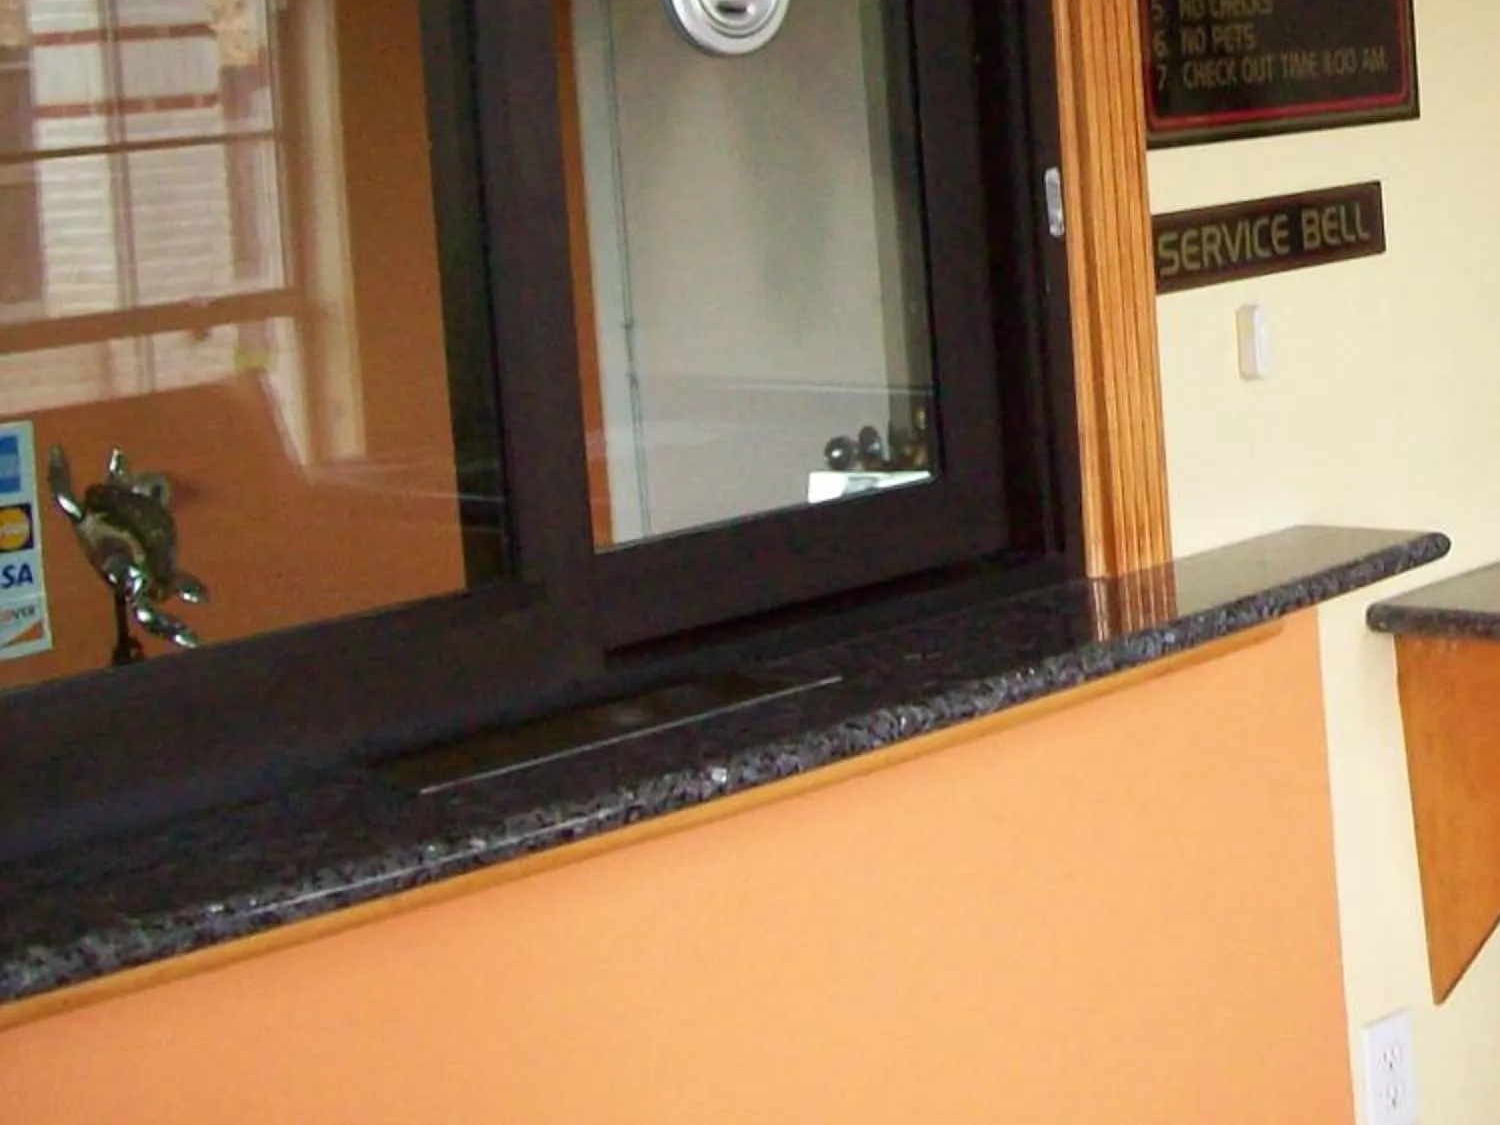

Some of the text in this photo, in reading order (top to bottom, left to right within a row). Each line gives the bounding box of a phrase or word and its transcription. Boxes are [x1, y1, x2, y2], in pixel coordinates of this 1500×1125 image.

[1181, 27, 1207, 57] NO
[1211, 23, 1259, 55] PETS
[1183, 57, 1238, 92] CHECK
[1241, 54, 1275, 86] OUT
[1157, 201, 1371, 277] SERVICE BELL
[0, 563, 34, 589] SA
